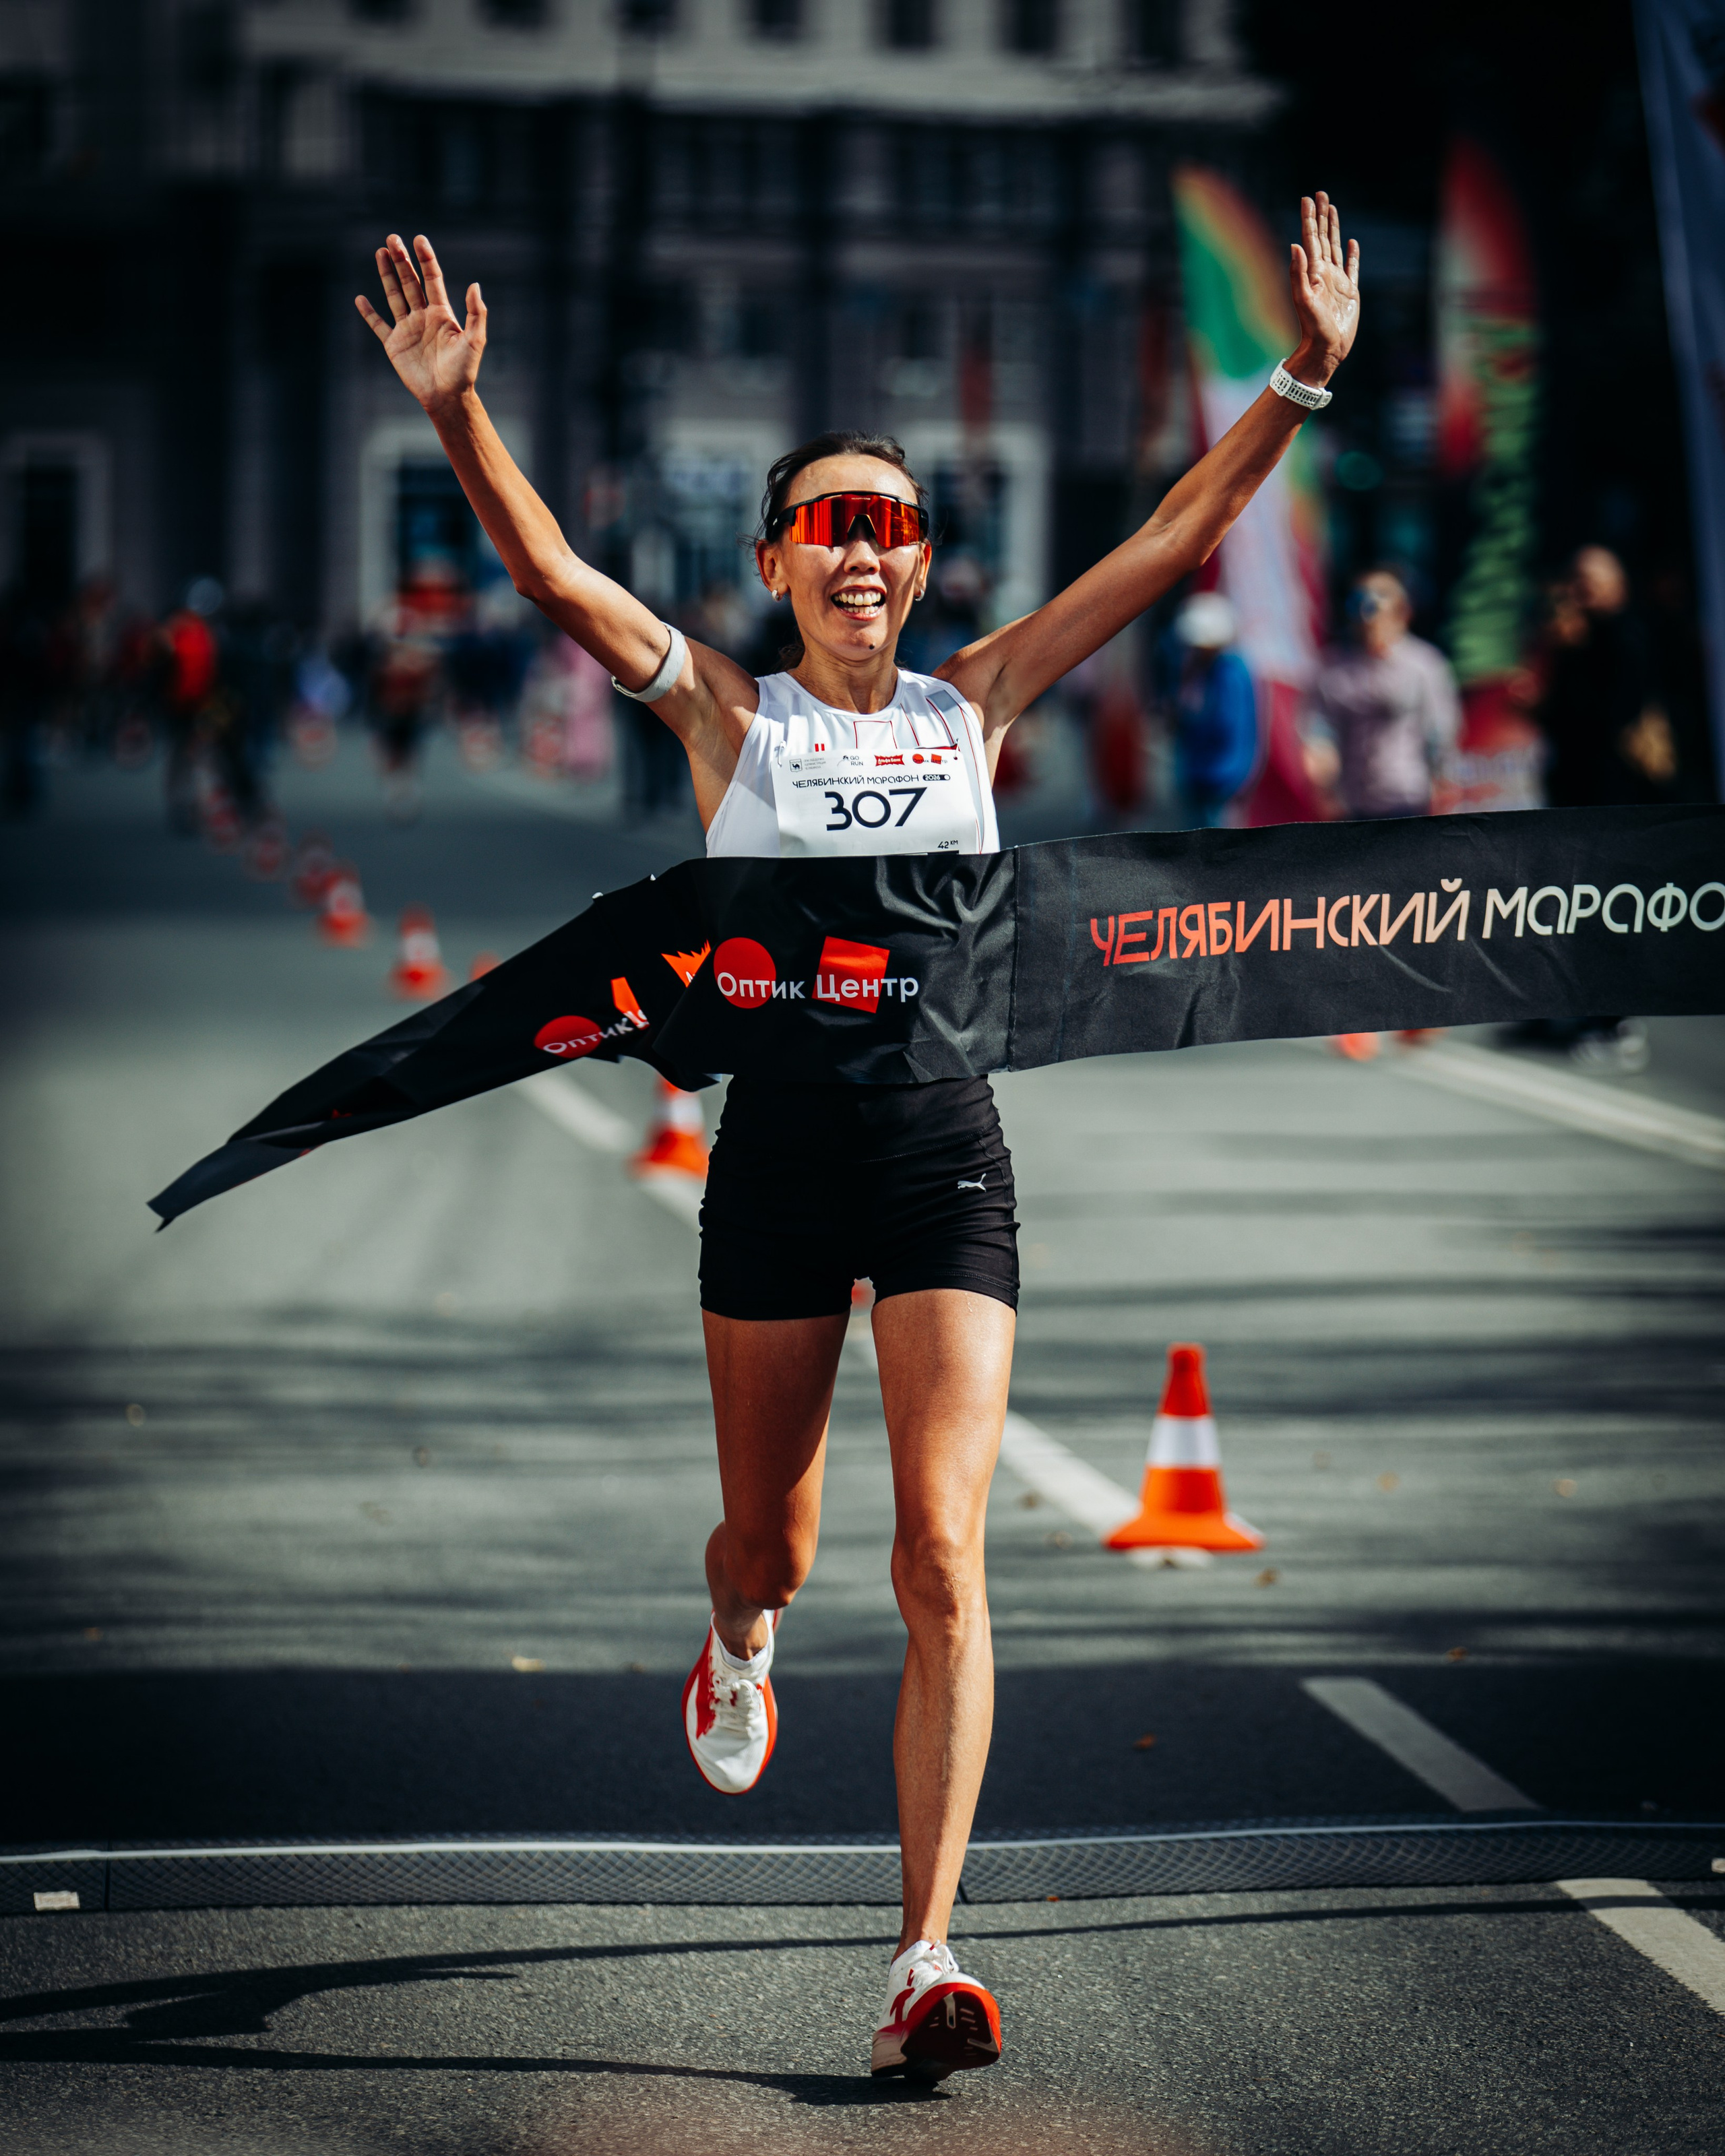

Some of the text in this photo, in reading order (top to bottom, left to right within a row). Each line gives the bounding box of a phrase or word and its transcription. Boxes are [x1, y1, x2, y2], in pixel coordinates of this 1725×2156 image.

[792, 775, 865, 788] ЧЕЛЯБИНСКИЙ
[867, 774, 919, 785] МАРАФОН
[824, 787, 928, 831] 307
[937, 841, 949, 849] 42
[1089, 877, 1472, 966] ЧЕЛЯБИНСКИЙ
[717, 972, 805, 999] Оптик
[816, 974, 918, 1002] Центр
[542, 1017, 634, 1054] Оптик
